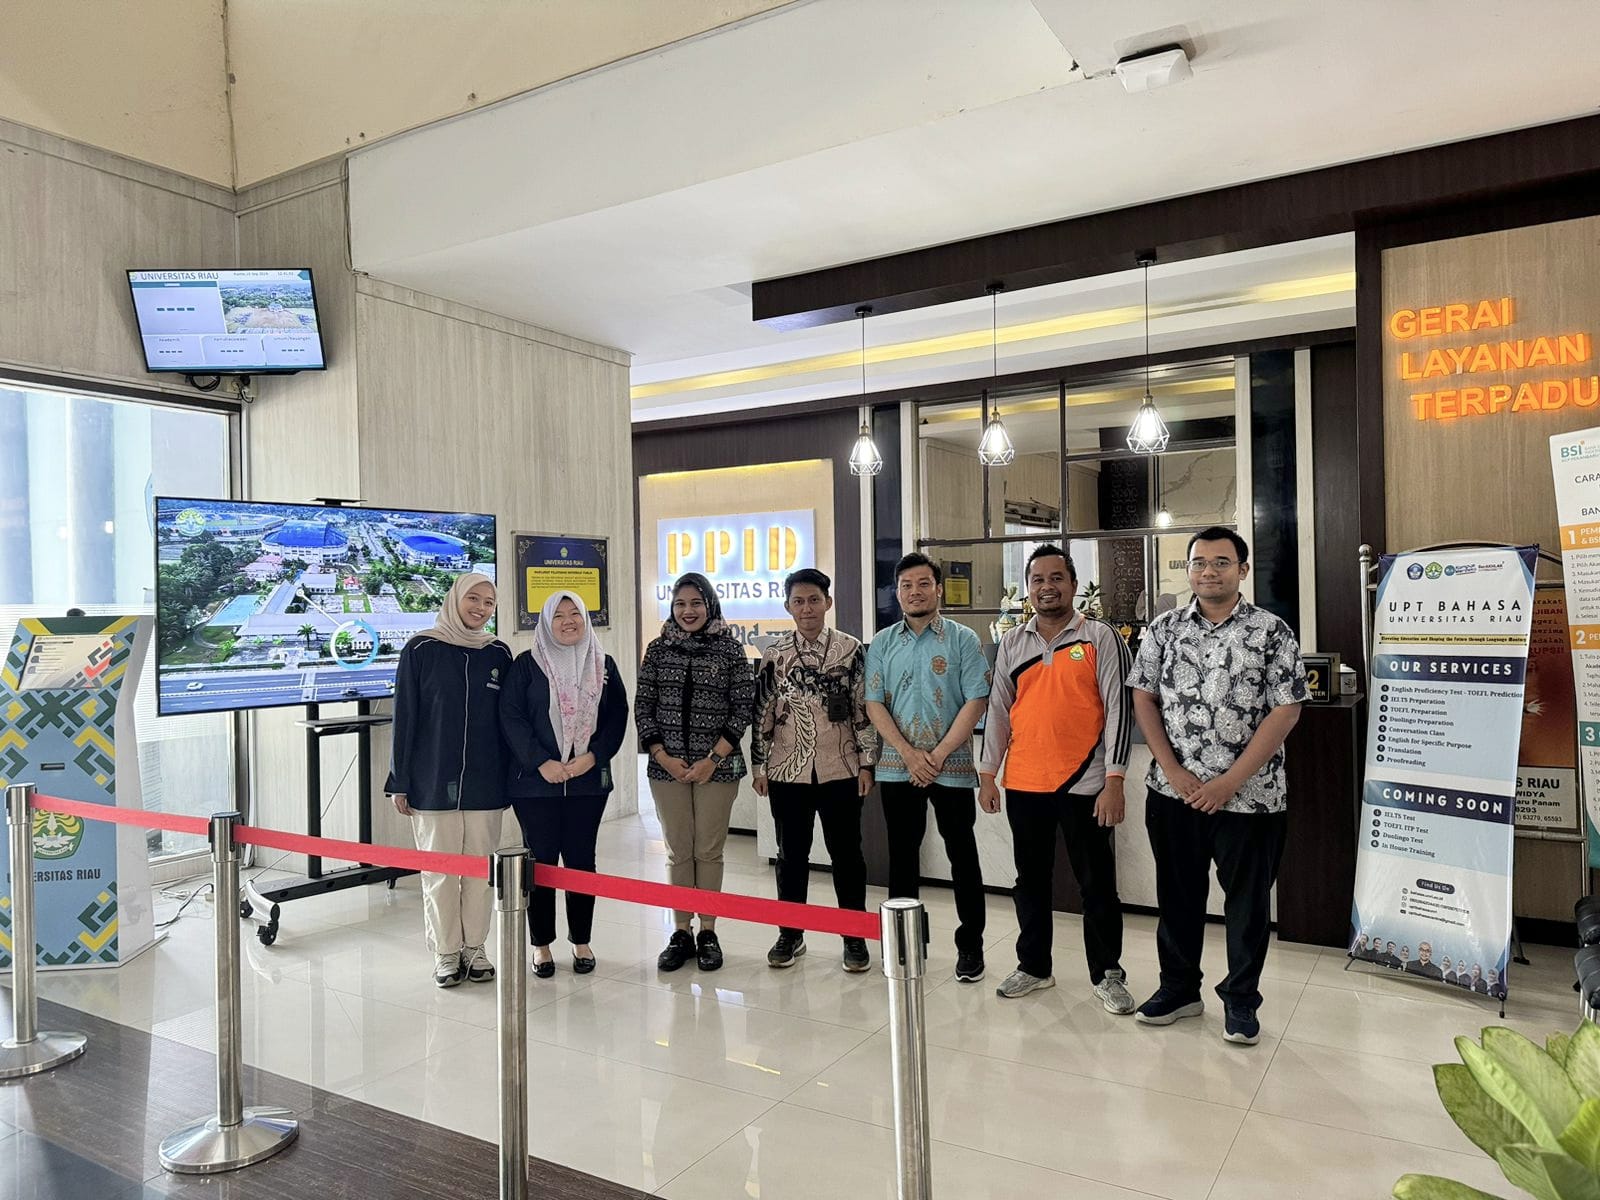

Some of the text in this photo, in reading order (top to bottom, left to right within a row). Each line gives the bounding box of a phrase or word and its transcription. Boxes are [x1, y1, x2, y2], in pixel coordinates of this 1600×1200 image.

[141, 272, 219, 280] UNIVERSITAS RIAU
[1390, 297, 1510, 339] GERAI
[1402, 334, 1586, 380] LAYANAN
[1411, 376, 1599, 420] TERPADU
[1560, 446, 1582, 458] BSI
[1568, 530, 1576, 545] 1
[667, 527, 797, 574] PPID
[1390, 600, 1522, 612] UPT BAHASA
[1576, 630, 1586, 644] 2
[1390, 661, 1512, 676] OUR SERVICES
[1307, 670, 1320, 690] 2
[1410, 697, 1445, 705] Preparation
[1418, 718, 1454, 726] Preparation
[1585, 726, 1595, 742] 3
[1422, 739, 1445, 747] Specific
[1388, 746, 1422, 755] Translation
[1387, 757, 1426, 767] Proofreading
[1528, 778, 1560, 789] RIAU
[1383, 788, 1503, 814] COMING SOON
[1382, 832, 1409, 842] Duolingo
[1390, 844, 1408, 852] House
[1409, 847, 1435, 858] Training
[76, 868, 101, 880] RIAU
